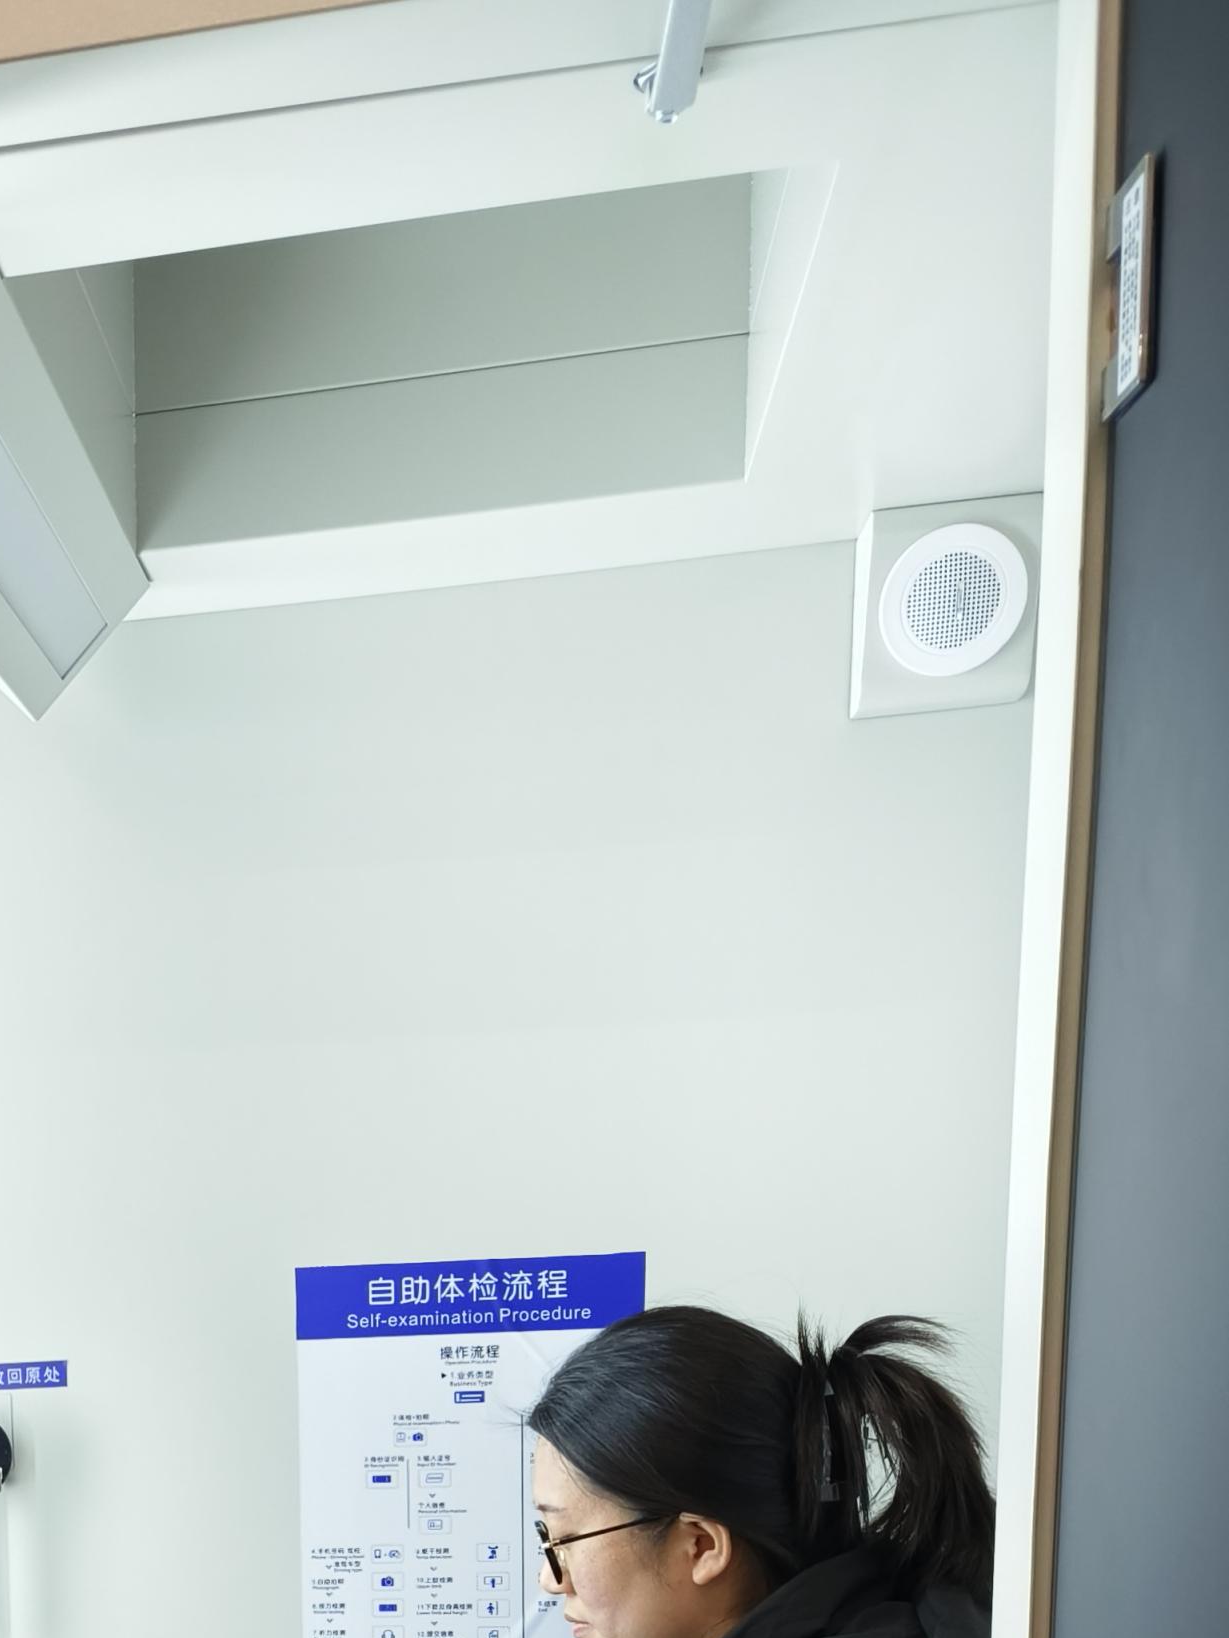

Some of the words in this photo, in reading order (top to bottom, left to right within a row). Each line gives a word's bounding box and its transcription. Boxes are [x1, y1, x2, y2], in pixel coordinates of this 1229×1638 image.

[368, 1270, 569, 1306] 自助体检流程
[347, 1308, 494, 1329] Self-examination
[499, 1306, 592, 1323] Procedure
[440, 1345, 500, 1360] 操作流程
